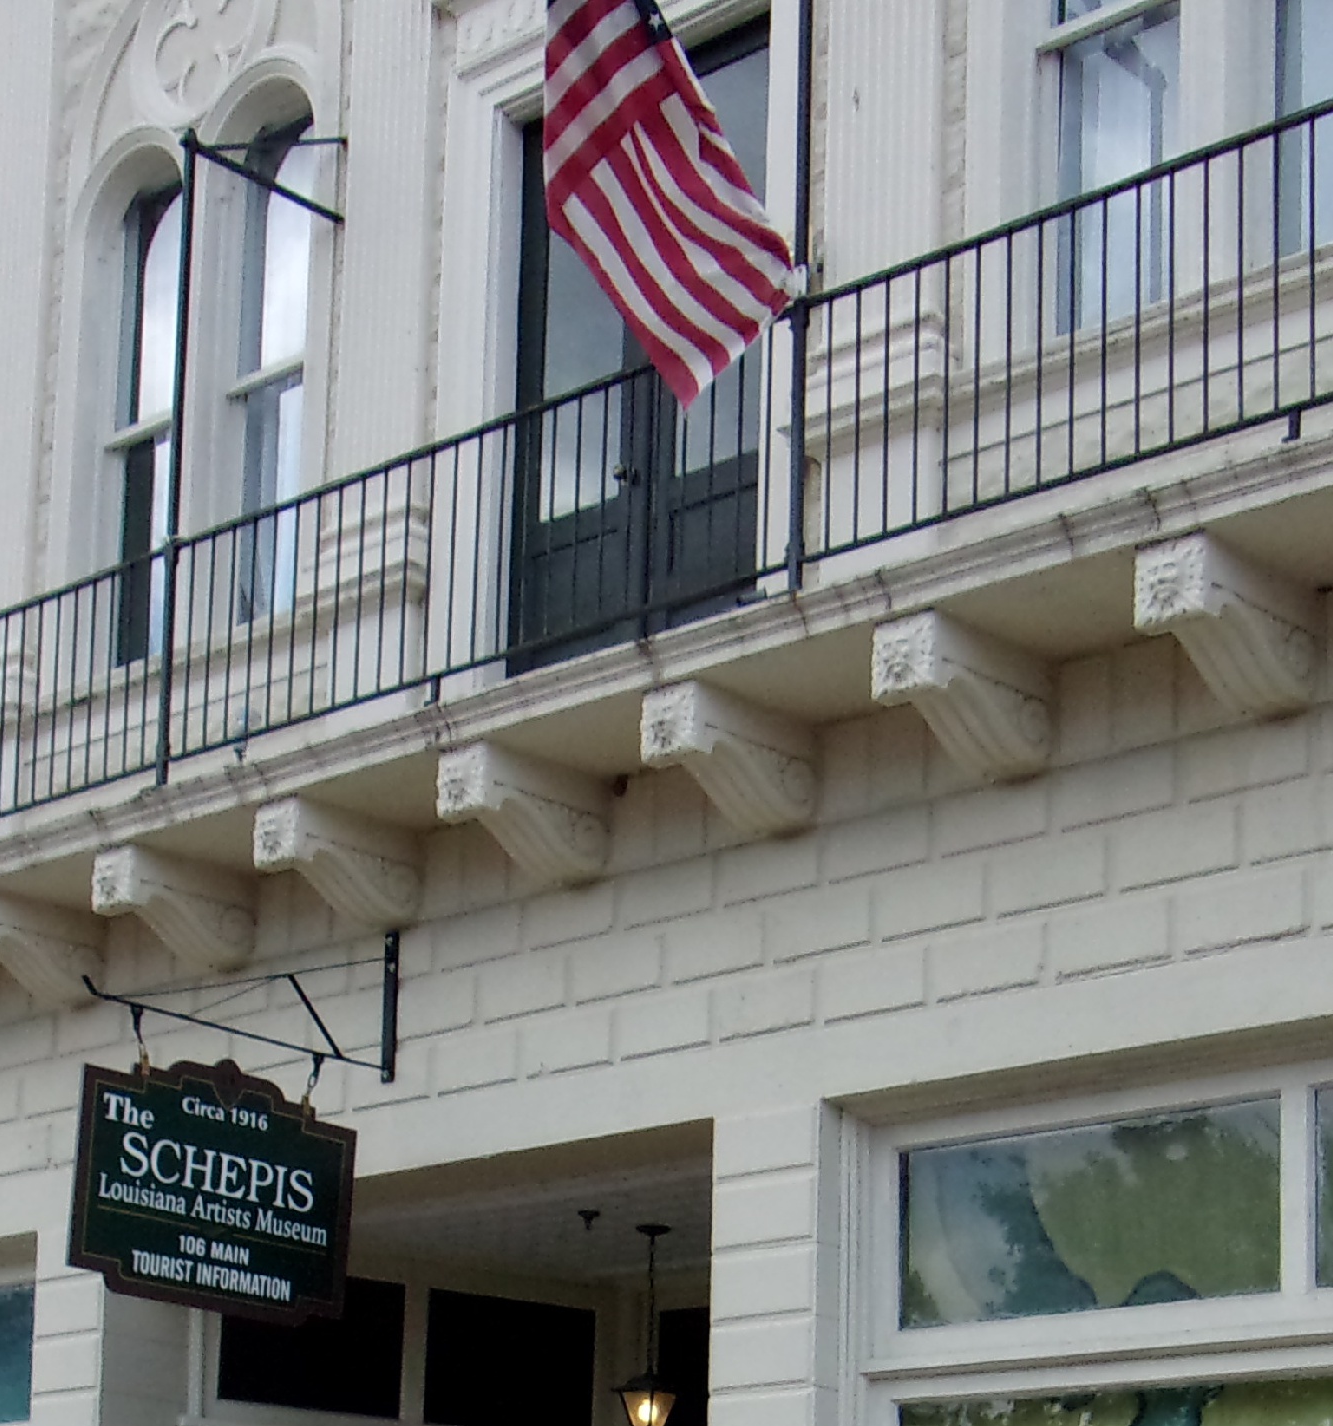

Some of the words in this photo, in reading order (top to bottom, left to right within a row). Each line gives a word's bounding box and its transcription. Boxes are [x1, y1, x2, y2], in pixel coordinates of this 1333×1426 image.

[104, 1092, 155, 1129] The
[182, 1096, 225, 1121] Circa
[231, 1107, 268, 1131] 1916
[120, 1131, 314, 1212] SCHEPIS
[98, 1171, 186, 1216] Louisiana
[190, 1194, 252, 1230] Artists
[255, 1207, 327, 1246] Museum
[179, 1235, 206, 1257] 106
[210, 1241, 250, 1266] MAIN
[132, 1250, 194, 1282] TOURIST
[196, 1262, 291, 1302] INFORMATION
